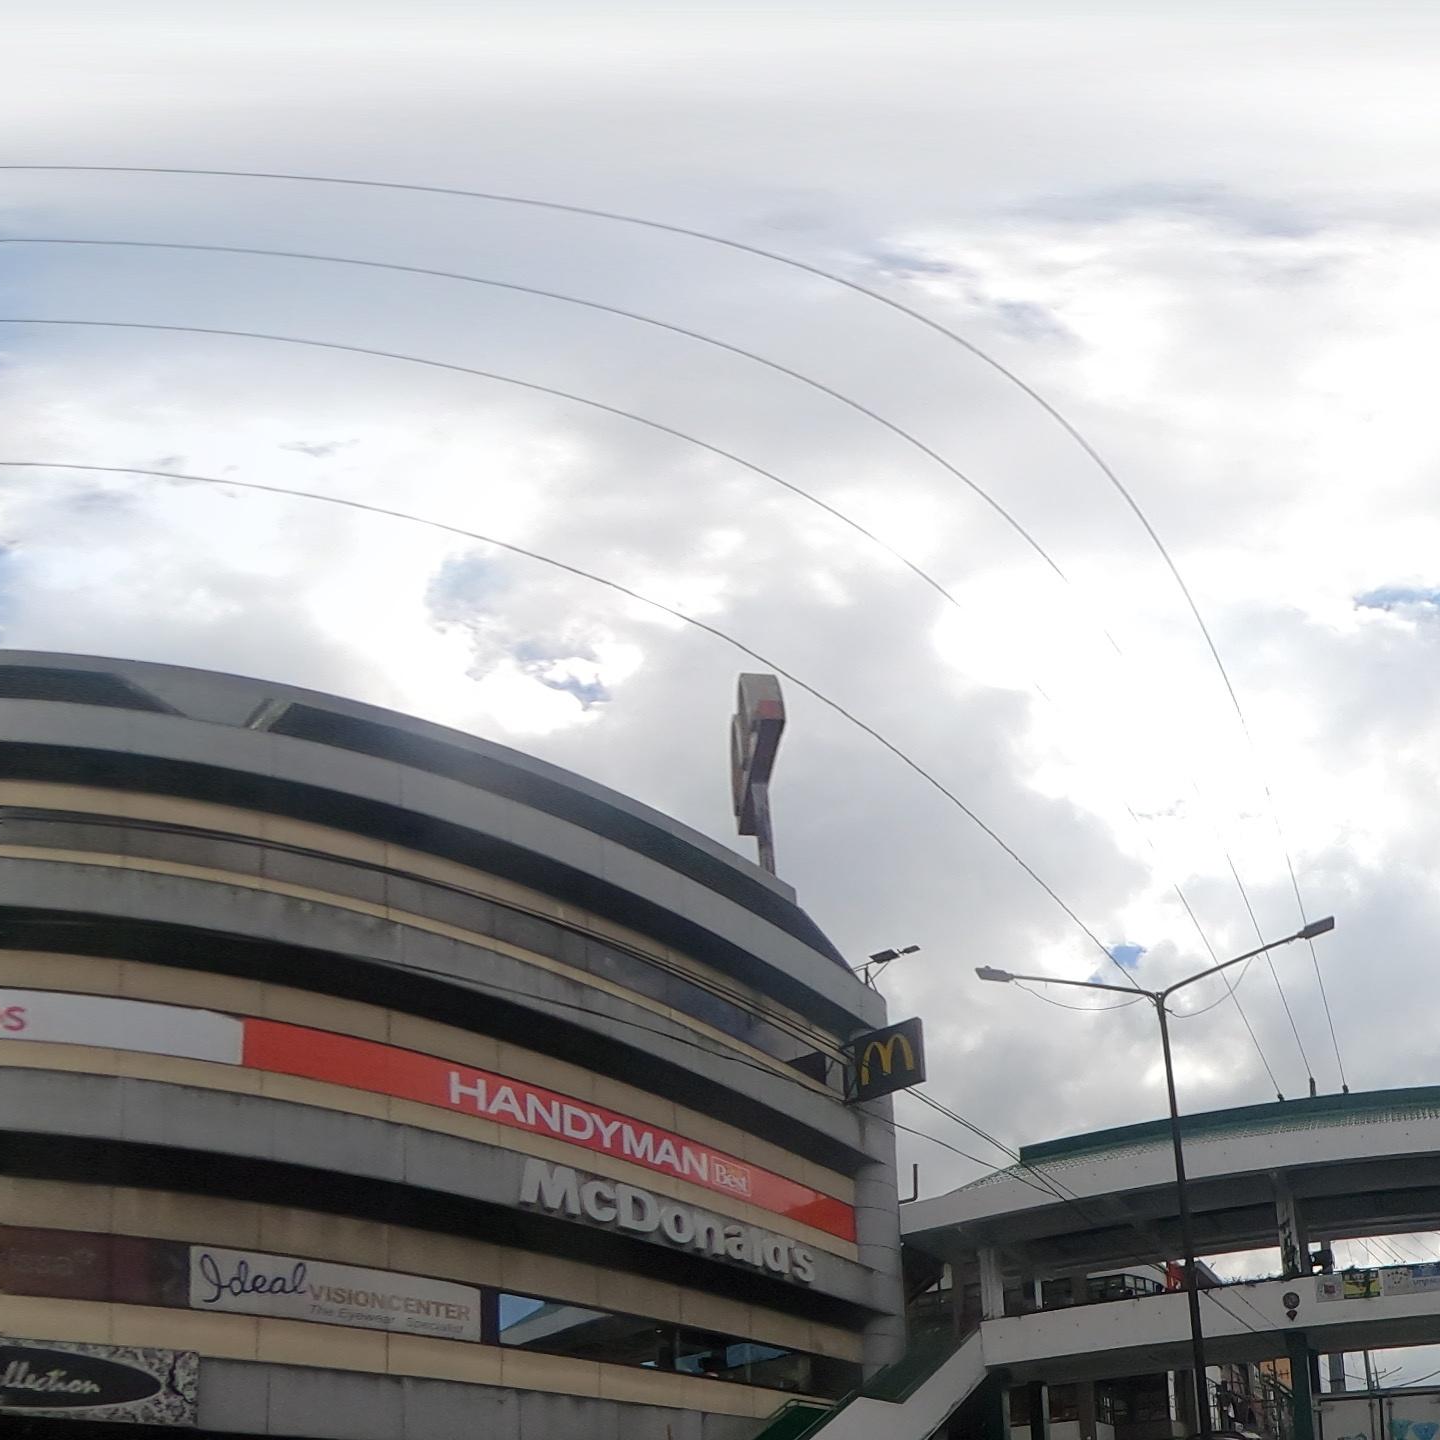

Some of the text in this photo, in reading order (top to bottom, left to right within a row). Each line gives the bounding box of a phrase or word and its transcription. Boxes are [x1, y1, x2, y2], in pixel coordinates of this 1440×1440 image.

[449, 1071, 749, 1191] HANDYMAN Best
[520, 1158, 815, 1282] McDonald's
[200, 1253, 471, 1321] Ideal VISION CENTER
[338, 1307, 395, 1325] Eyewear
